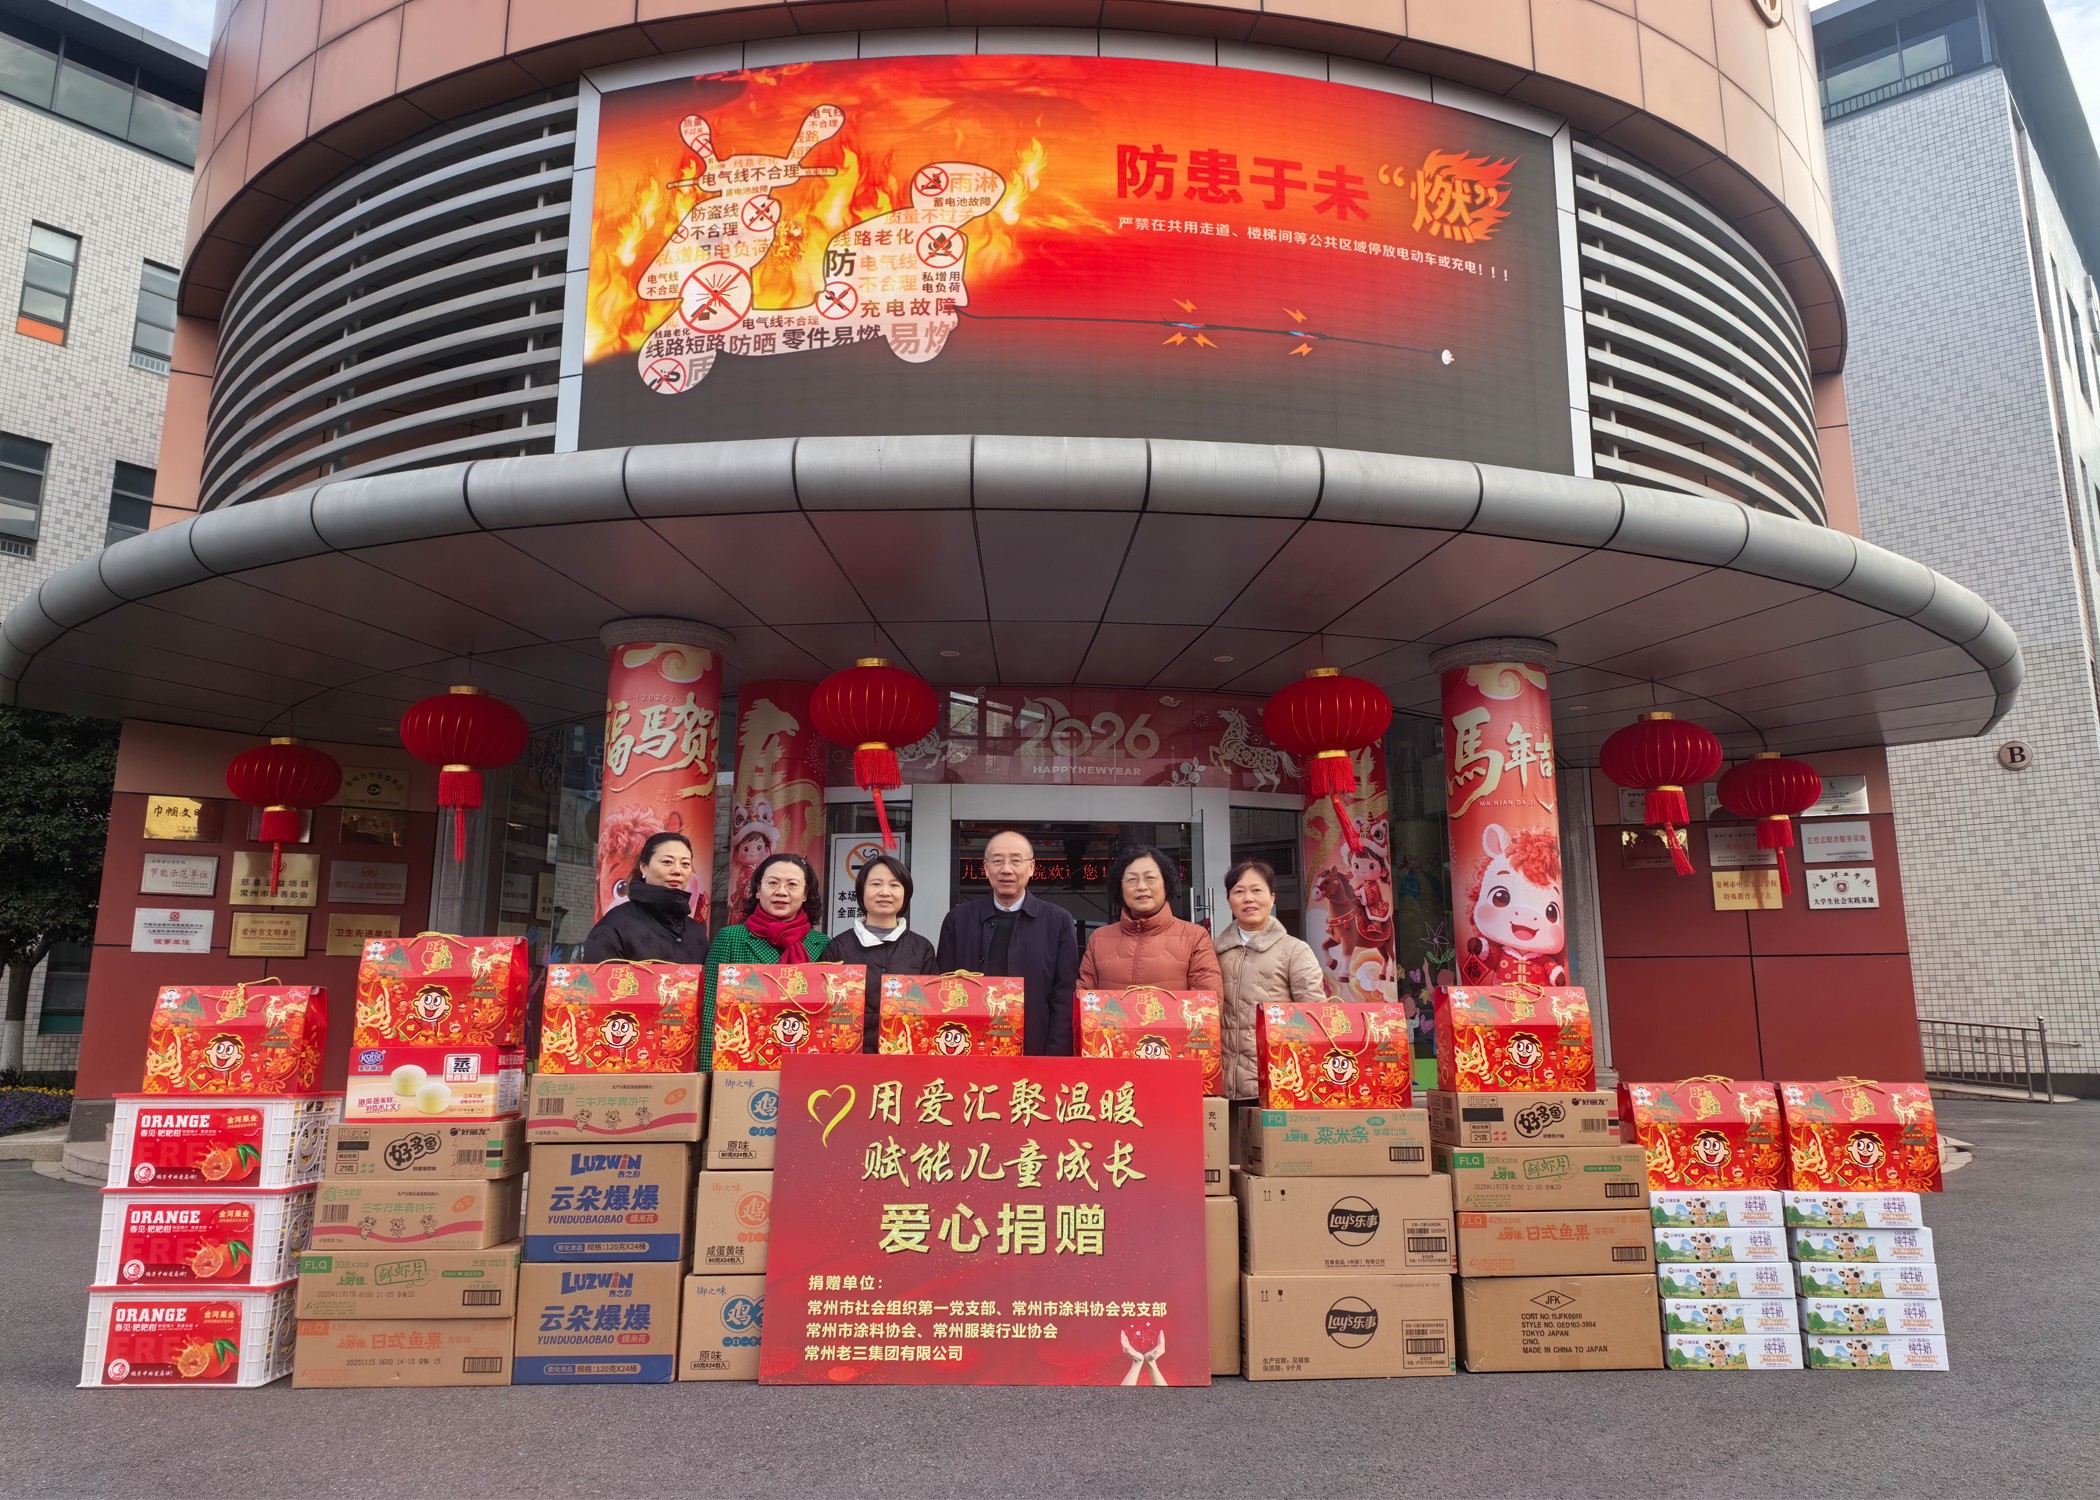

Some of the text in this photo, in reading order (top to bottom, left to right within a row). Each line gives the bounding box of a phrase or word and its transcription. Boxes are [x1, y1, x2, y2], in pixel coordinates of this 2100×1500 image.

[809, 120, 838, 128] 不合理
[733, 158, 778, 168] 线路老化
[702, 164, 800, 186] 电气线不合理
[951, 172, 998, 193] 雨淋
[725, 185, 768, 196] 蓄电池故障
[934, 197, 991, 207] 蓄电池故障
[691, 203, 739, 222] 防盗线
[886, 208, 976, 224] 质量不过关
[690, 222, 739, 240] 不合理
[834, 229, 914, 247] 线路老化
[657, 239, 772, 266] 私增用电负荷
[826, 248, 857, 278] 防
[861, 254, 917, 271] 电气线
[648, 271, 679, 284] 电气线
[922, 272, 960, 282] 私增用
[647, 284, 679, 296] 不合理
[859, 275, 917, 293] 不合理
[922, 282, 960, 293] 电负荷
[860, 298, 956, 318] 充电故障
[742, 316, 819, 330] 电气线不合理
[655, 328, 690, 338] 线路老化
[645, 333, 726, 358] 线路短路
[730, 333, 776, 355] 防晒
[1013, 697, 1160, 760] 2026
[2006, 746, 2026, 764] B
[150, 867, 208, 879] 节能示范单位
[240, 889, 309, 899] 常州市善总会
[1814, 896, 1875, 906] 大学生社会实践基地
[335, 928, 393, 938] 卫生先进单位
[453, 1057, 471, 1073] 蒸
[725, 1078, 755, 1089] 御之味
[575, 1097, 649, 1107] 三牛万年青饼干
[868, 1077, 1145, 1127] 用爱汇聚温暖
[141, 1115, 210, 1128] ORANGE
[227, 1115, 258, 1124] 金河果业
[1268, 1115, 1283, 1125] FQ
[1519, 1105, 1562, 1134] 好多鱼
[1373, 1128, 1407, 1137] 草莓口味
[389, 1136, 438, 1166] 好多鱼
[727, 1140, 750, 1151] 原味
[861, 1135, 1147, 1191] 赋能儿童成长
[1459, 1156, 1480, 1166] FLQ
[1527, 1158, 1568, 1177] 鲜虾片
[712, 1182, 742, 1193] 御之味
[549, 1185, 659, 1212] 云朵爆爆
[361, 1203, 437, 1213] 三牛万年青饼干
[1745, 1201, 1767, 1212] 纯牛奶
[1884, 1201, 1906, 1212] 纯牛奶
[130, 1211, 200, 1224] ORANGE
[219, 1210, 249, 1218] 金河果业
[548, 1215, 623, 1224] YUNDUOBAOBAO
[1461, 1216, 1482, 1225] FLQ
[878, 1203, 1106, 1256] 爱心捐赠
[1527, 1224, 1590, 1241] 日式鱼果
[1750, 1235, 1772, 1246] 纯牛奶
[1894, 1236, 1917, 1247] 纯牛奶
[706, 1246, 745, 1257] 咸蛋黄味
[304, 1261, 328, 1270] FLQ
[378, 1262, 423, 1282] 鲜虾片
[1756, 1271, 1778, 1282] 纯牛奶
[1900, 1271, 1923, 1283] 纯牛奶
[808, 1275, 884, 1292] 捐赠单位：
[696, 1286, 727, 1296] 御之味
[1545, 1296, 1560, 1304] JFK
[204, 1310, 235, 1319] 金河果业
[807, 1300, 1168, 1317] 常州市社会组织第一党支部、常州市涂料协会党支部
[1762, 1307, 1784, 1318] 纯牛奶
[1904, 1307, 1926, 1318] 纯牛奶
[115, 1308, 187, 1322] ORANGE
[539, 1304, 651, 1332] 云朵爆爆
[806, 1322, 1059, 1339] 常州市涂料协会、常州服装行业协会
[371, 1332, 443, 1350] 日式鱼果
[537, 1335, 614, 1345] YUNDUOBAOBAO
[804, 1345, 964, 1362] 常州老三集团有限公司
[1764, 1342, 1787, 1354] 纯牛奶
[1909, 1342, 1932, 1354] 纯牛奶
[699, 1351, 722, 1362] 原味
